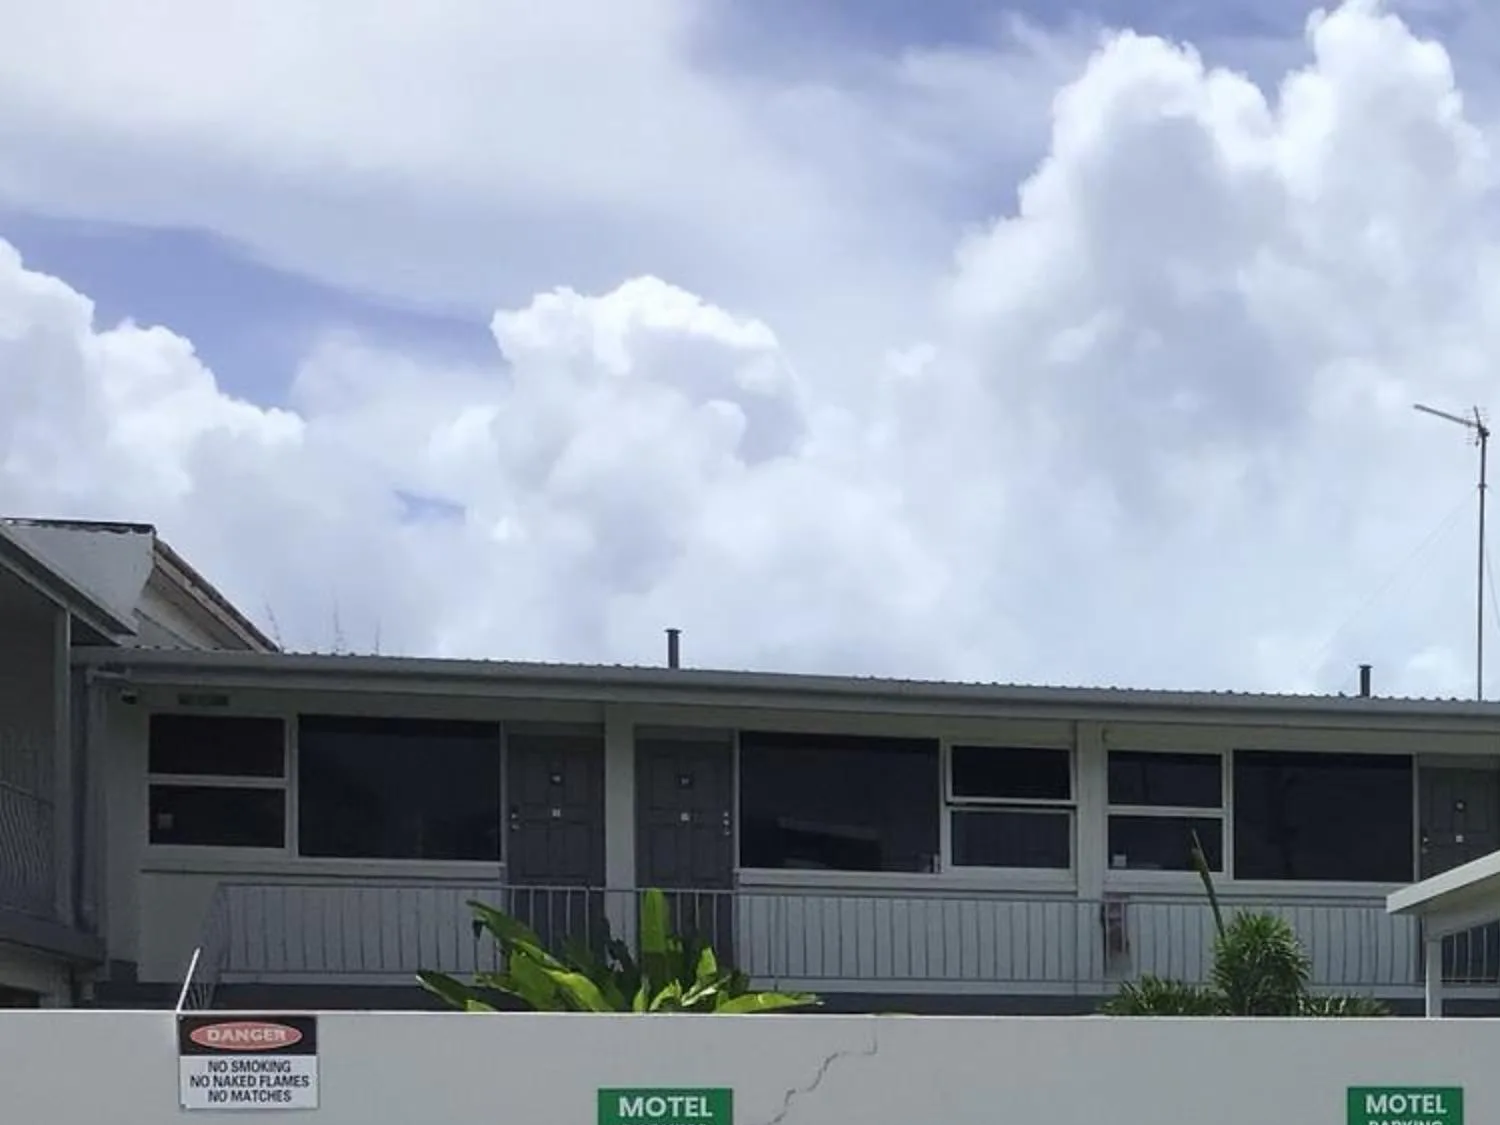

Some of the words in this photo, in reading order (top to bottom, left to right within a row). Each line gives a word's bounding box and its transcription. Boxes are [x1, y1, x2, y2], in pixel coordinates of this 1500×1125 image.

[207, 1029, 286, 1042] DANGER
[208, 1060, 228, 1073] NO
[231, 1060, 291, 1073] SMOKING
[190, 1075, 210, 1087] NO
[213, 1075, 256, 1087] NAKED
[259, 1075, 309, 1087] FLAMES
[208, 1090, 227, 1102] NO
[231, 1090, 292, 1102] MATCHES
[619, 1096, 713, 1117] MOTEL
[1365, 1093, 1448, 1115] MOTEL
